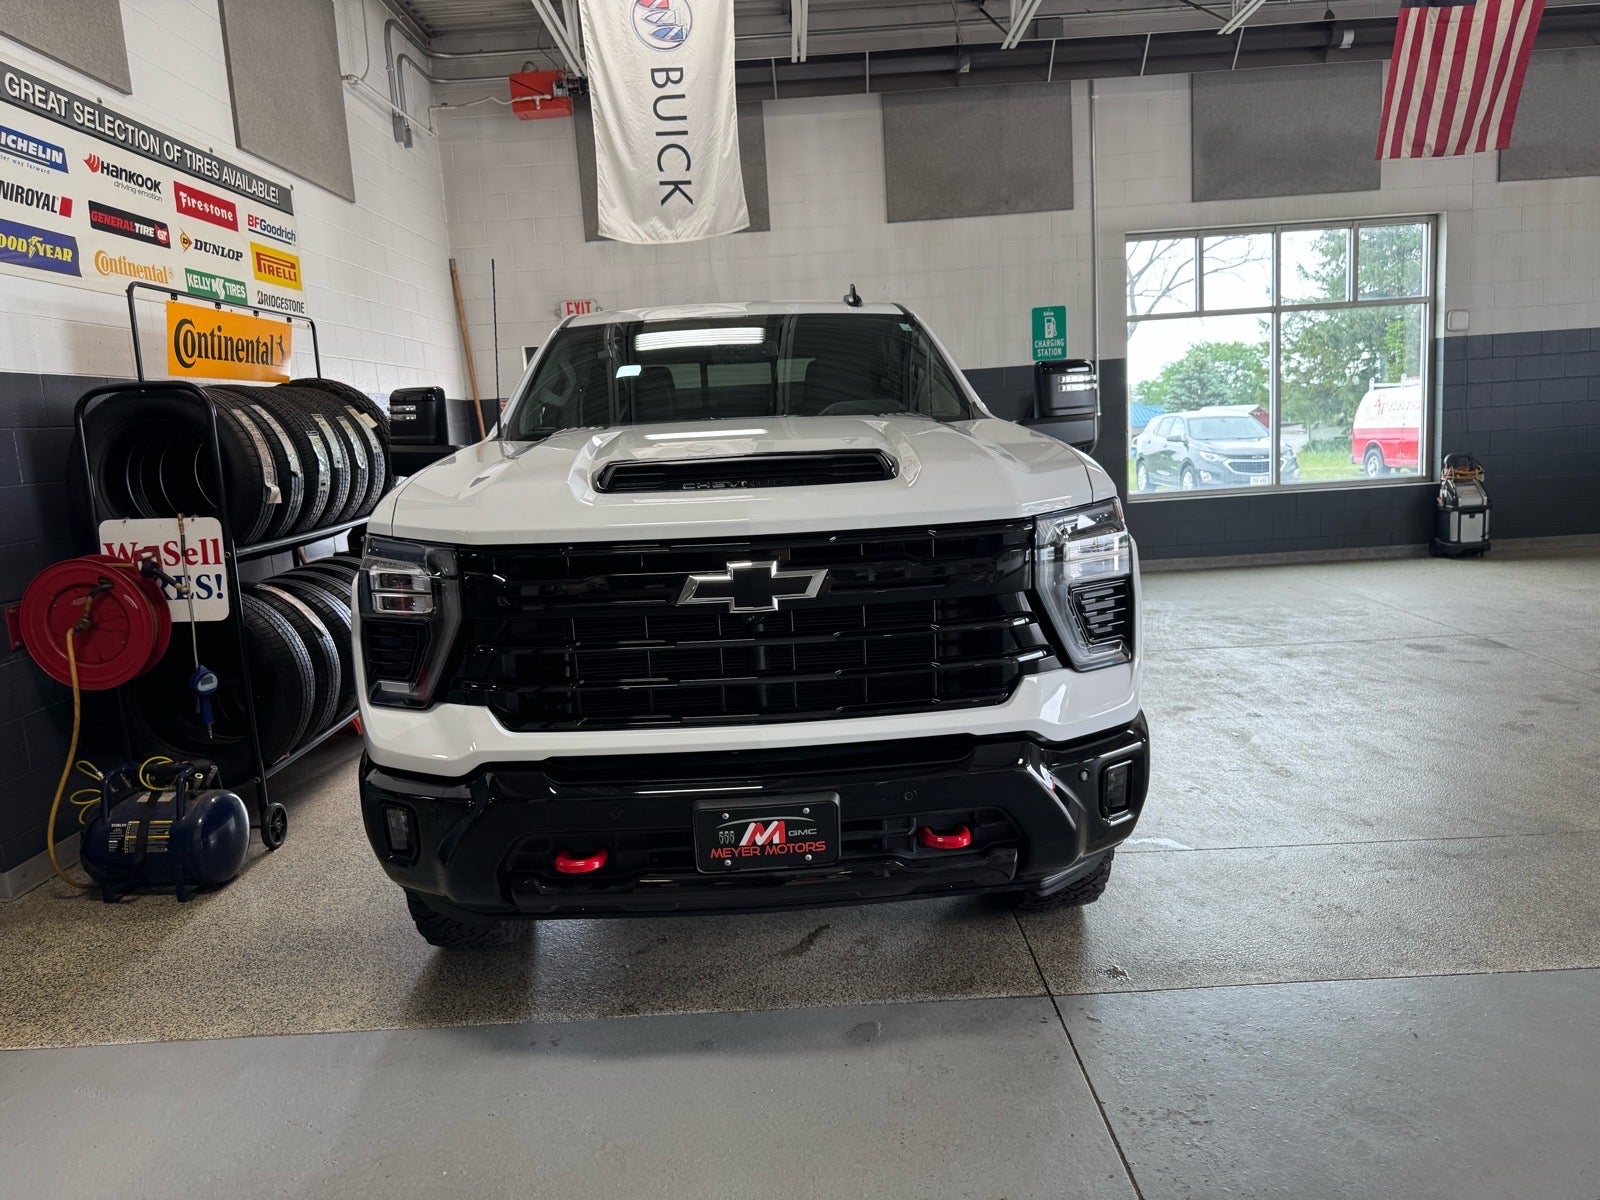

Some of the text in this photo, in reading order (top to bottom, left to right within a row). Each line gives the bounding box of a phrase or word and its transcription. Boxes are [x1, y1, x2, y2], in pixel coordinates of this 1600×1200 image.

[0, 132, 63, 164] ICHELIN
[4, 72, 279, 204] GREAT SELECTION OF TIRES AVAILABLE!
[650, 67, 693, 206] BUICK
[0, 180, 57, 214] NIROYAL
[114, 180, 162, 203] driving emotion
[179, 191, 234, 222] Firestone
[248, 213, 296, 242] BFGoodrich
[0, 233, 73, 262] OODYEAR
[194, 239, 243, 261] DUNLOP
[94, 249, 169, 284] Continental
[255, 251, 298, 282] PIRELLI
[187, 273, 211, 291] KELLY
[225, 282, 246, 298] TIRES
[257, 290, 305, 313] BRIDGESTONE
[566, 301, 592, 316] EXIT
[174, 318, 274, 368] Continental
[1034, 338, 1065, 348] CHARGING
[1037, 348, 1062, 357] STATION
[163, 538, 223, 567] Sell
[788, 828, 817, 837] GMC
[710, 840, 826, 859] MEYER MOTORS
